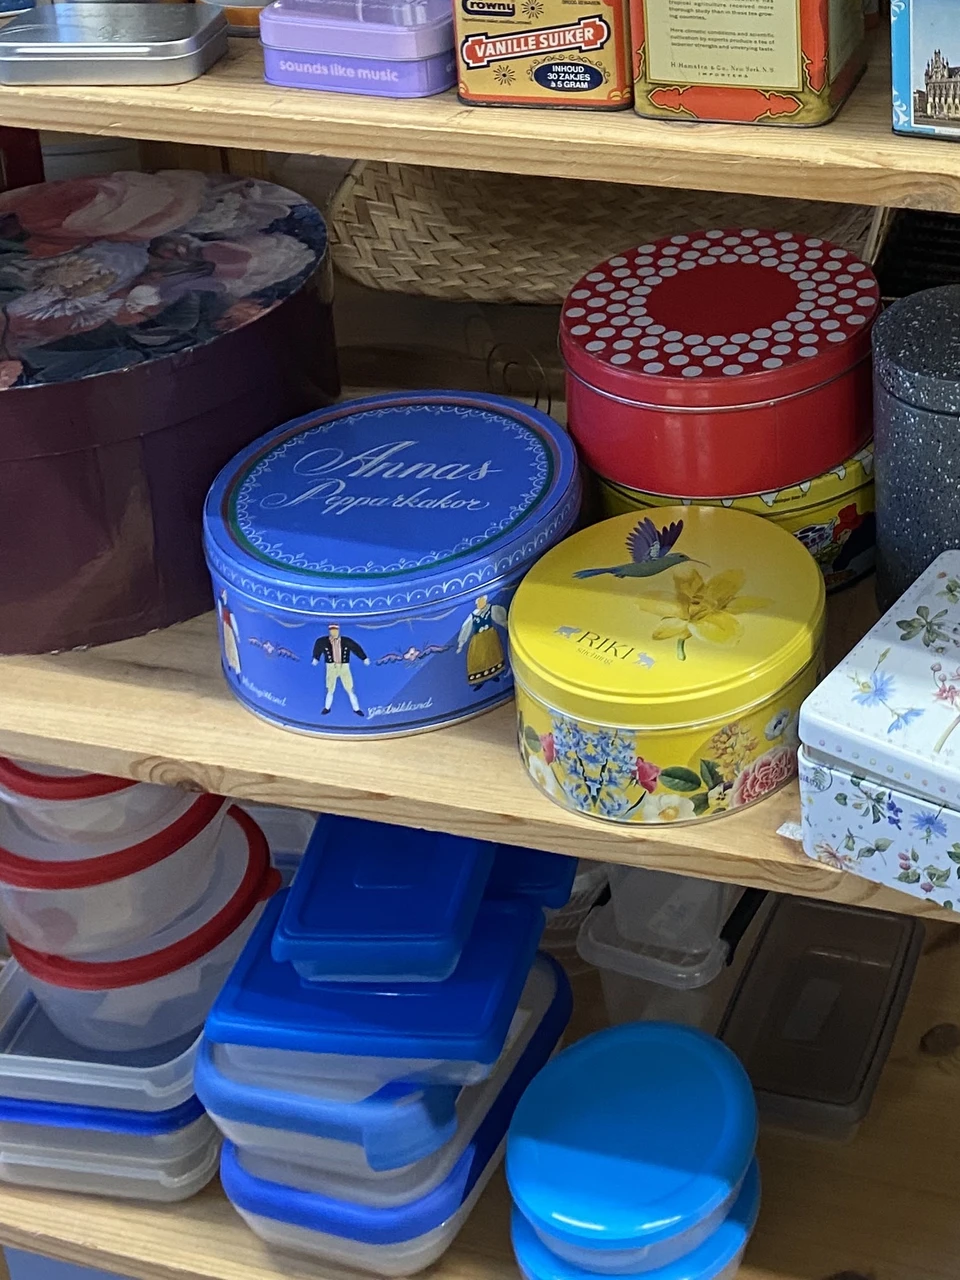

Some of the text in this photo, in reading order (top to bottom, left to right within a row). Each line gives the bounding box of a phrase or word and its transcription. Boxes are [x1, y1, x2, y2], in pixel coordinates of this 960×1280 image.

[475, 27, 595, 58] VANILLE SUIKER
[279, 60, 399, 82] sounds like music
[547, 73, 591, 81] 30 ZAKJES
[552, 65, 584, 73] INHOUD
[564, 81, 588, 89] GRAM
[294, 440, 503, 481] Annas
[260, 478, 490, 516] Pepparkakor
[576, 631, 635, 660] RIKI
